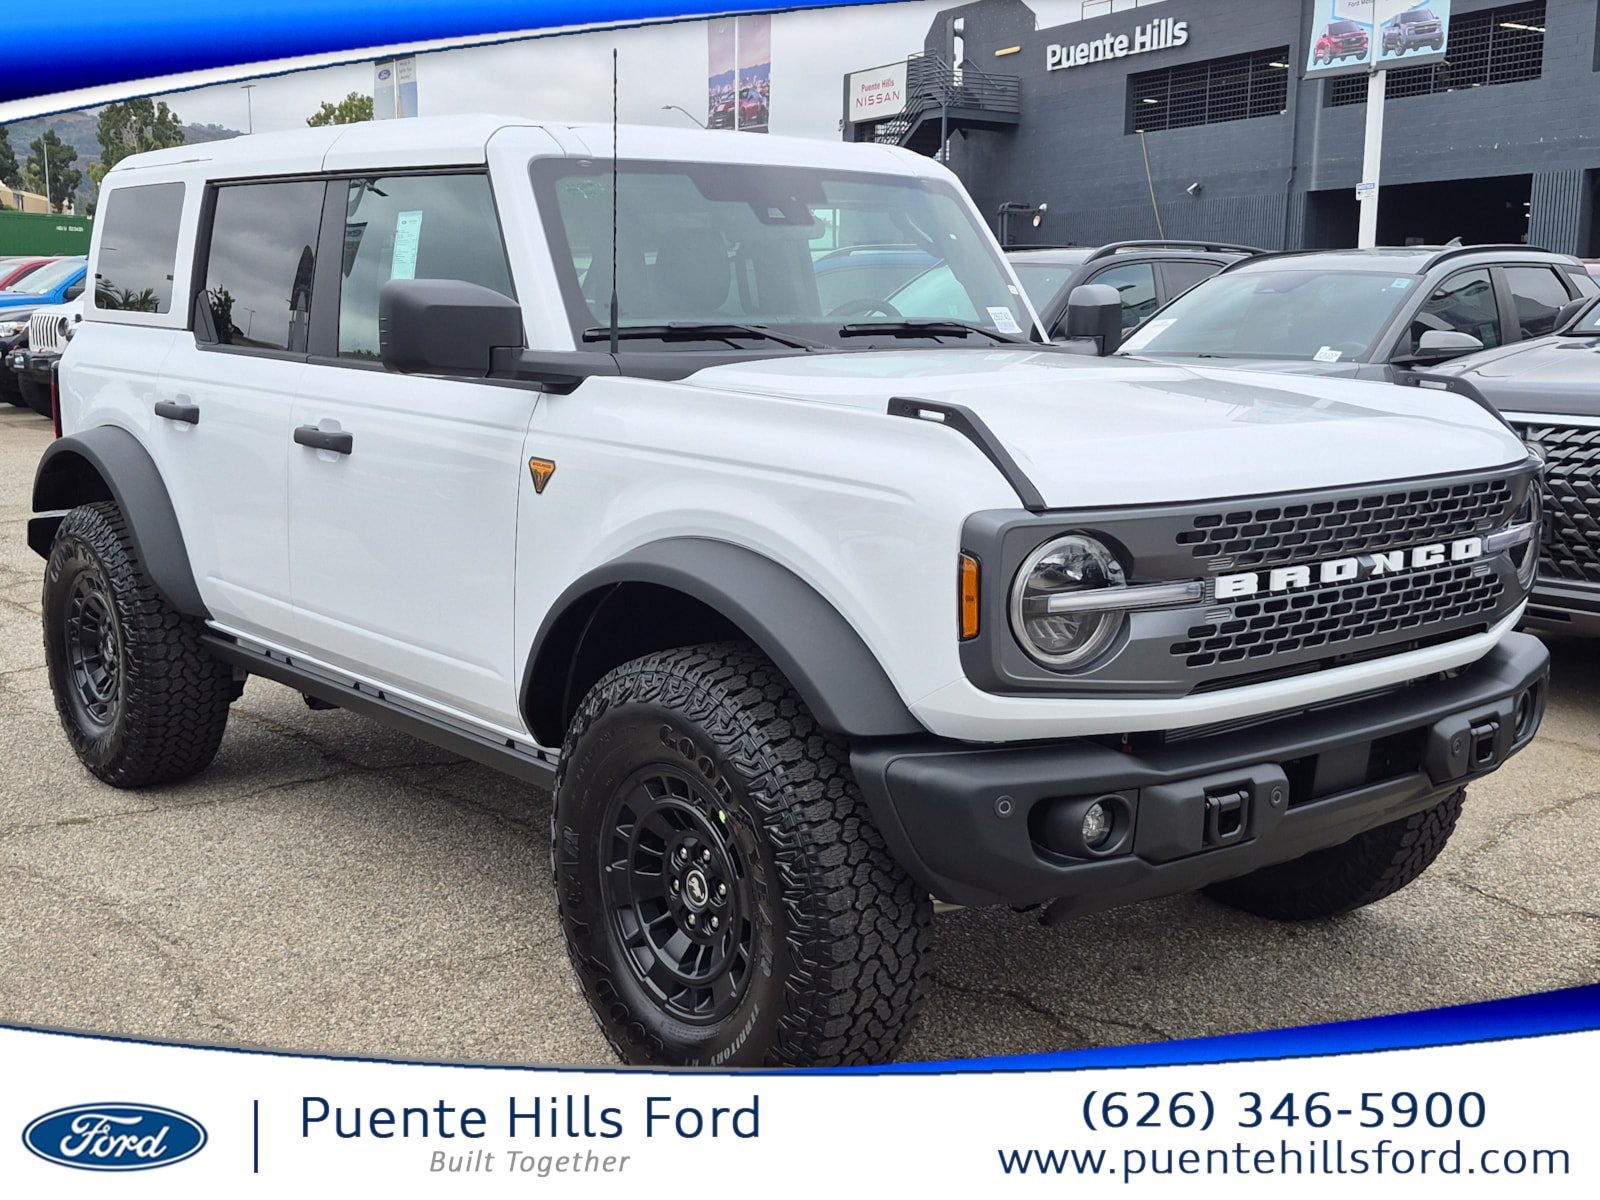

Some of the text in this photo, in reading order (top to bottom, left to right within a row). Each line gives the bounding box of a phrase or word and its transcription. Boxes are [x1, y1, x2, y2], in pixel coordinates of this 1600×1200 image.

[1046, 17, 1189, 72] Puente Hills
[856, 90, 900, 108] NISSAN
[861, 79, 895, 92] Puente Hills
[1214, 537, 1482, 600] BRONCO
